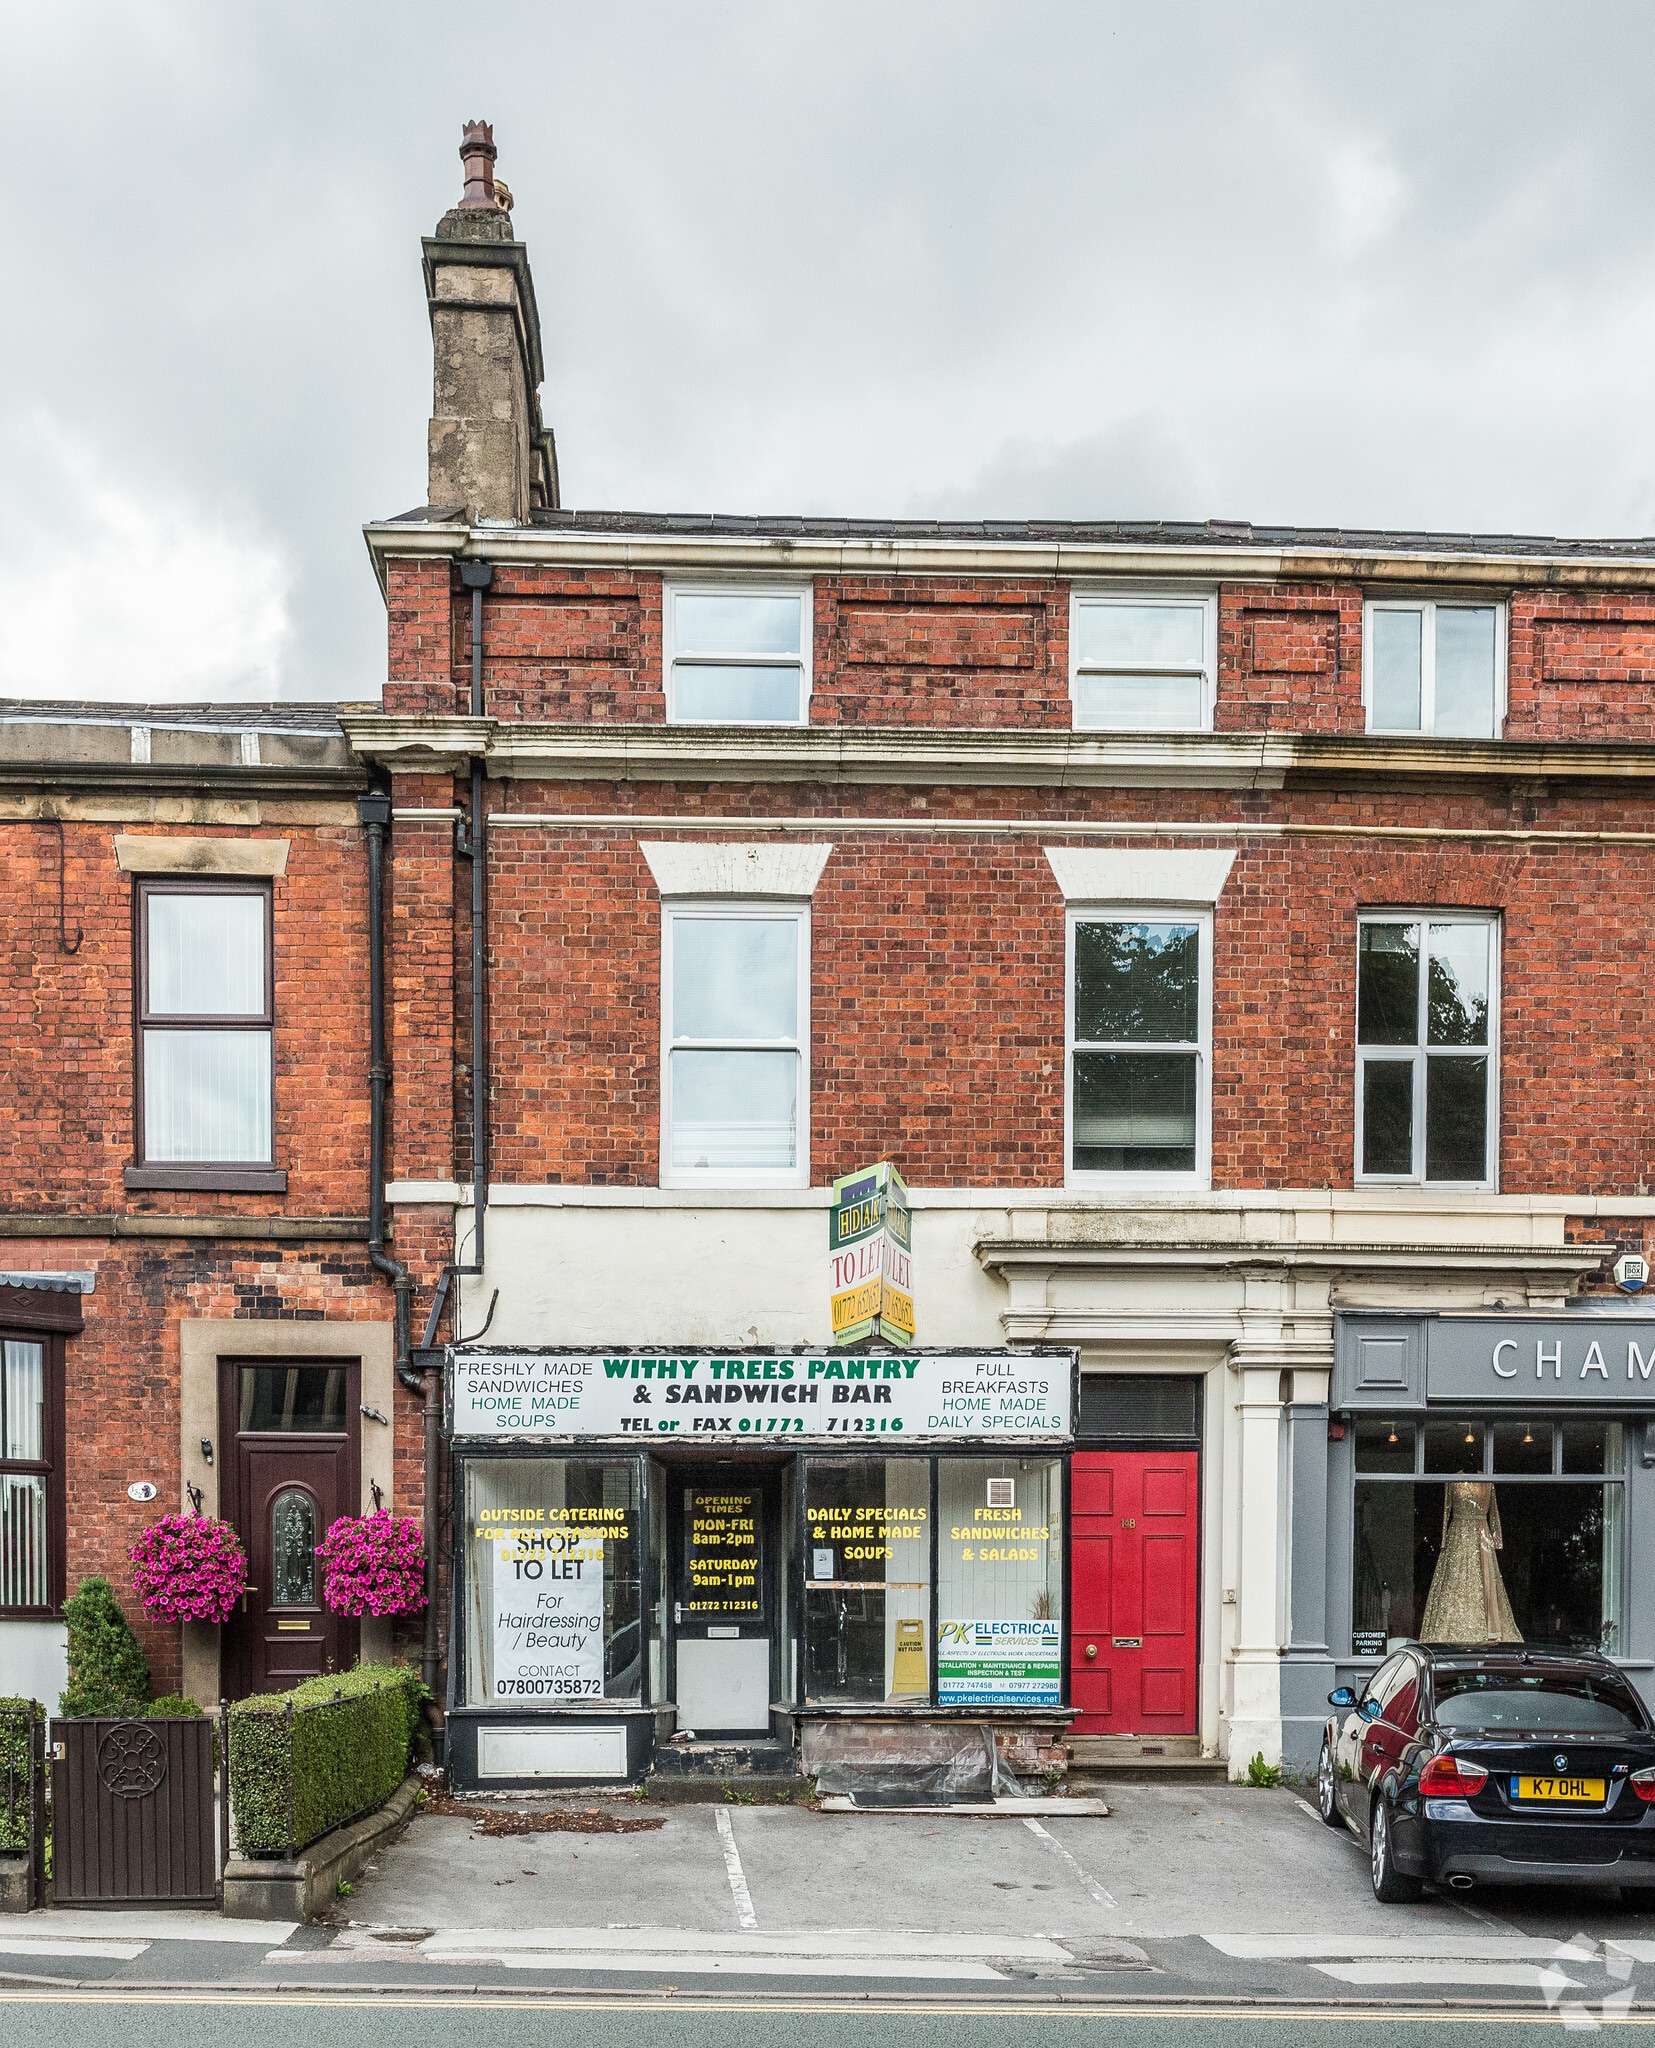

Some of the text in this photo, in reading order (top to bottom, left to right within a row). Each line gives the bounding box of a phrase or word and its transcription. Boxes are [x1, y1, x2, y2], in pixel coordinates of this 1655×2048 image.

[840, 1199, 879, 1236] HDAK
[832, 1236, 883, 1289] TO LET
[892, 1248, 911, 1290] LET
[1492, 1339, 1655, 1379] CHAM
[457, 1362, 593, 1376] FRESHLY MADE
[602, 1359, 921, 1380] WITHY TREES PANTRY
[976, 1363, 1015, 1376] FULL
[467, 1380, 583, 1393] SANDWICHES
[942, 1381, 1049, 1394] BREAKFASTS
[632, 1384, 893, 1404] & SANDWICH BAR
[471, 1397, 580, 1410] HOME MADE
[942, 1398, 1047, 1411] HOME MADE
[496, 1414, 556, 1427] SOUPS
[621, 1417, 904, 1432] TEL or FAX 01772 712316
[927, 1415, 1061, 1428] DAILY SPECIALS
[695, 1496, 752, 1505] OPENING
[480, 1508, 625, 1521] OUTSIDE CATERING
[704, 1505, 743, 1513] TIMES
[807, 1508, 927, 1521] DAILY SPECIALS
[974, 1508, 1022, 1521] FRESH
[693, 1519, 753, 1531] MON-FRI
[1121, 1518, 1136, 1529] 148
[475, 1526, 629, 1540] FOR ALL OCCASIONS
[812, 1526, 922, 1539] & HOME MADE
[950, 1527, 1050, 1540] SANDWICHES
[517, 1532, 580, 1554] SHOP
[692, 1533, 755, 1546] 8am-2pm
[500, 1549, 605, 1561] 01772 712316
[844, 1546, 894, 1559] SOUPS
[962, 1548, 975, 1561] &
[979, 1548, 1038, 1561] SALADS
[513, 1560, 584, 1580] TO LET
[689, 1559, 758, 1570] SATURDAY
[692, 1573, 755, 1587] 9am-1pm
[537, 1593, 564, 1609] For
[689, 1601, 758, 1610] 01772 712316
[498, 1612, 601, 1632] Hairdressing
[938, 1621, 1059, 1645] PK ELECTRICAL
[512, 1632, 587, 1652] / Beauty
[994, 1637, 1040, 1646] SERVICES
[518, 1665, 580, 1677] CONTACT
[497, 1680, 601, 1694] 07800735872
[943, 1681, 965, 1689] 01772
[966, 1681, 993, 1689] 747458
[1032, 1682, 1059, 1690] 272980
[938, 1694, 1058, 1704] ww.pkelectricalservices.net
[1533, 1779, 1591, 1796] K7 OHL
